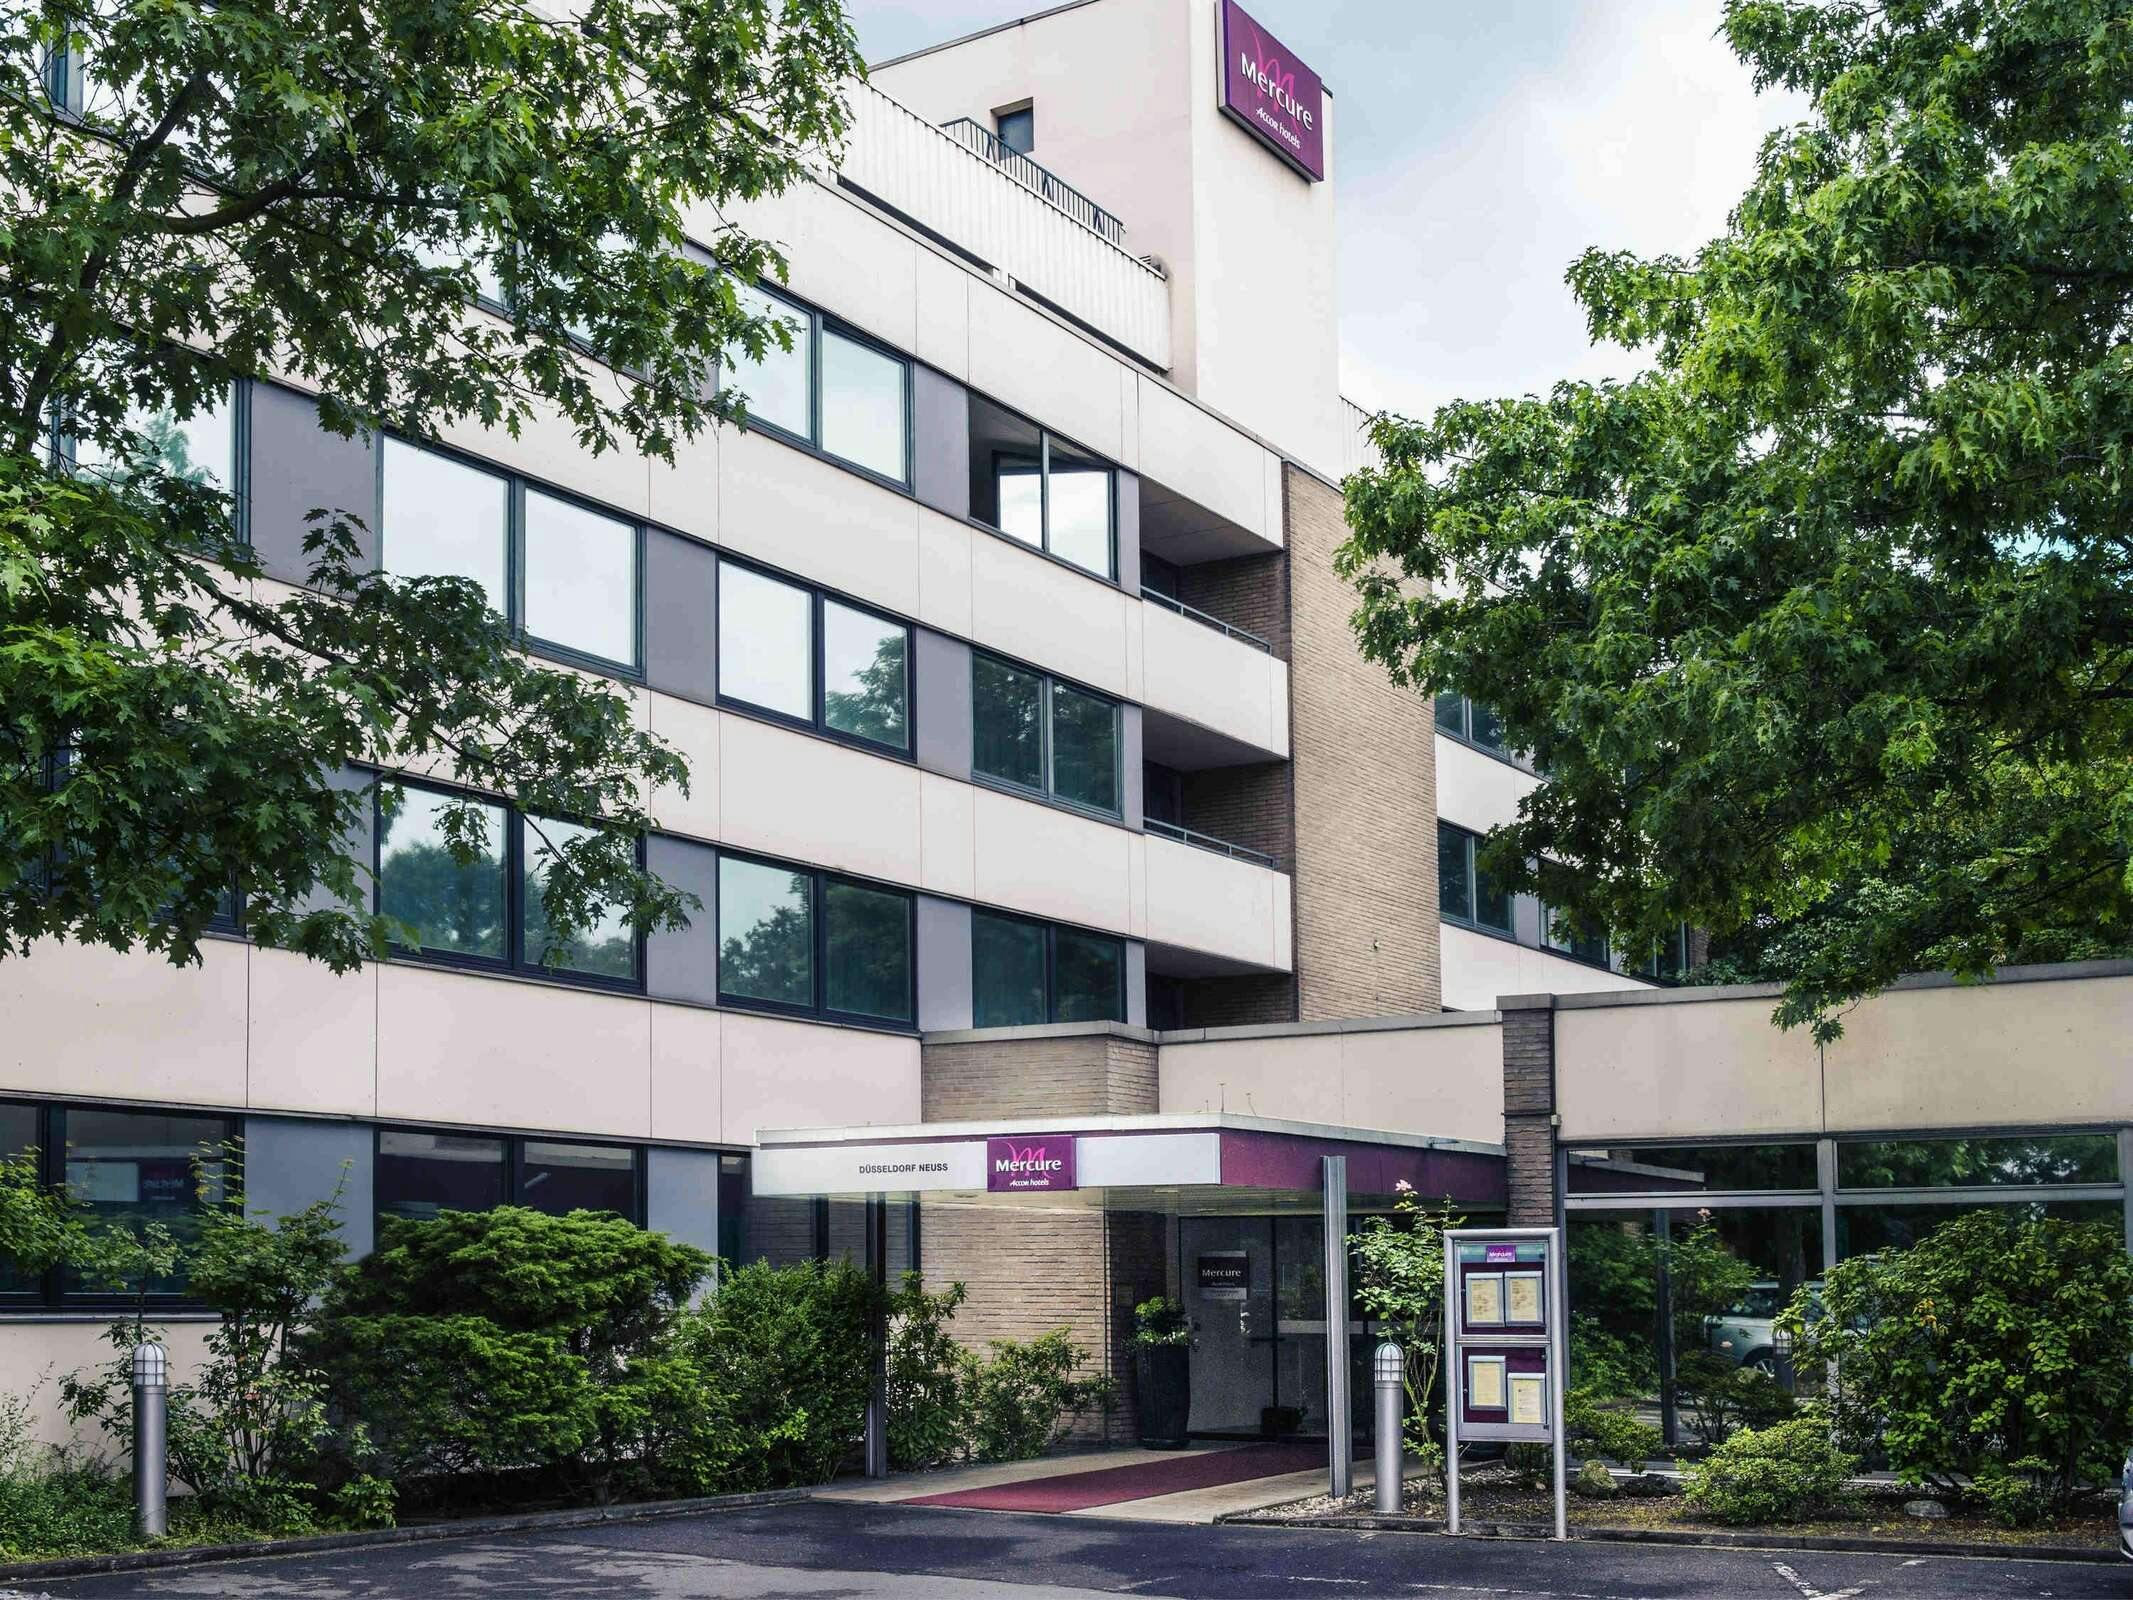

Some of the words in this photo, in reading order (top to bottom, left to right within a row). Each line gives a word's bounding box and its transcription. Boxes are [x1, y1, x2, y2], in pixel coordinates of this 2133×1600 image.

[1240, 52, 1313, 131] Mercure
[1279, 121, 1300, 149] hotels
[859, 1163, 917, 1174] DÜSSELDORF
[918, 1162, 948, 1172] NEUSS
[995, 1159, 1062, 1172] Mercure
[1030, 1178, 1049, 1186] hotels
[1201, 1269, 1241, 1278] Mercure
